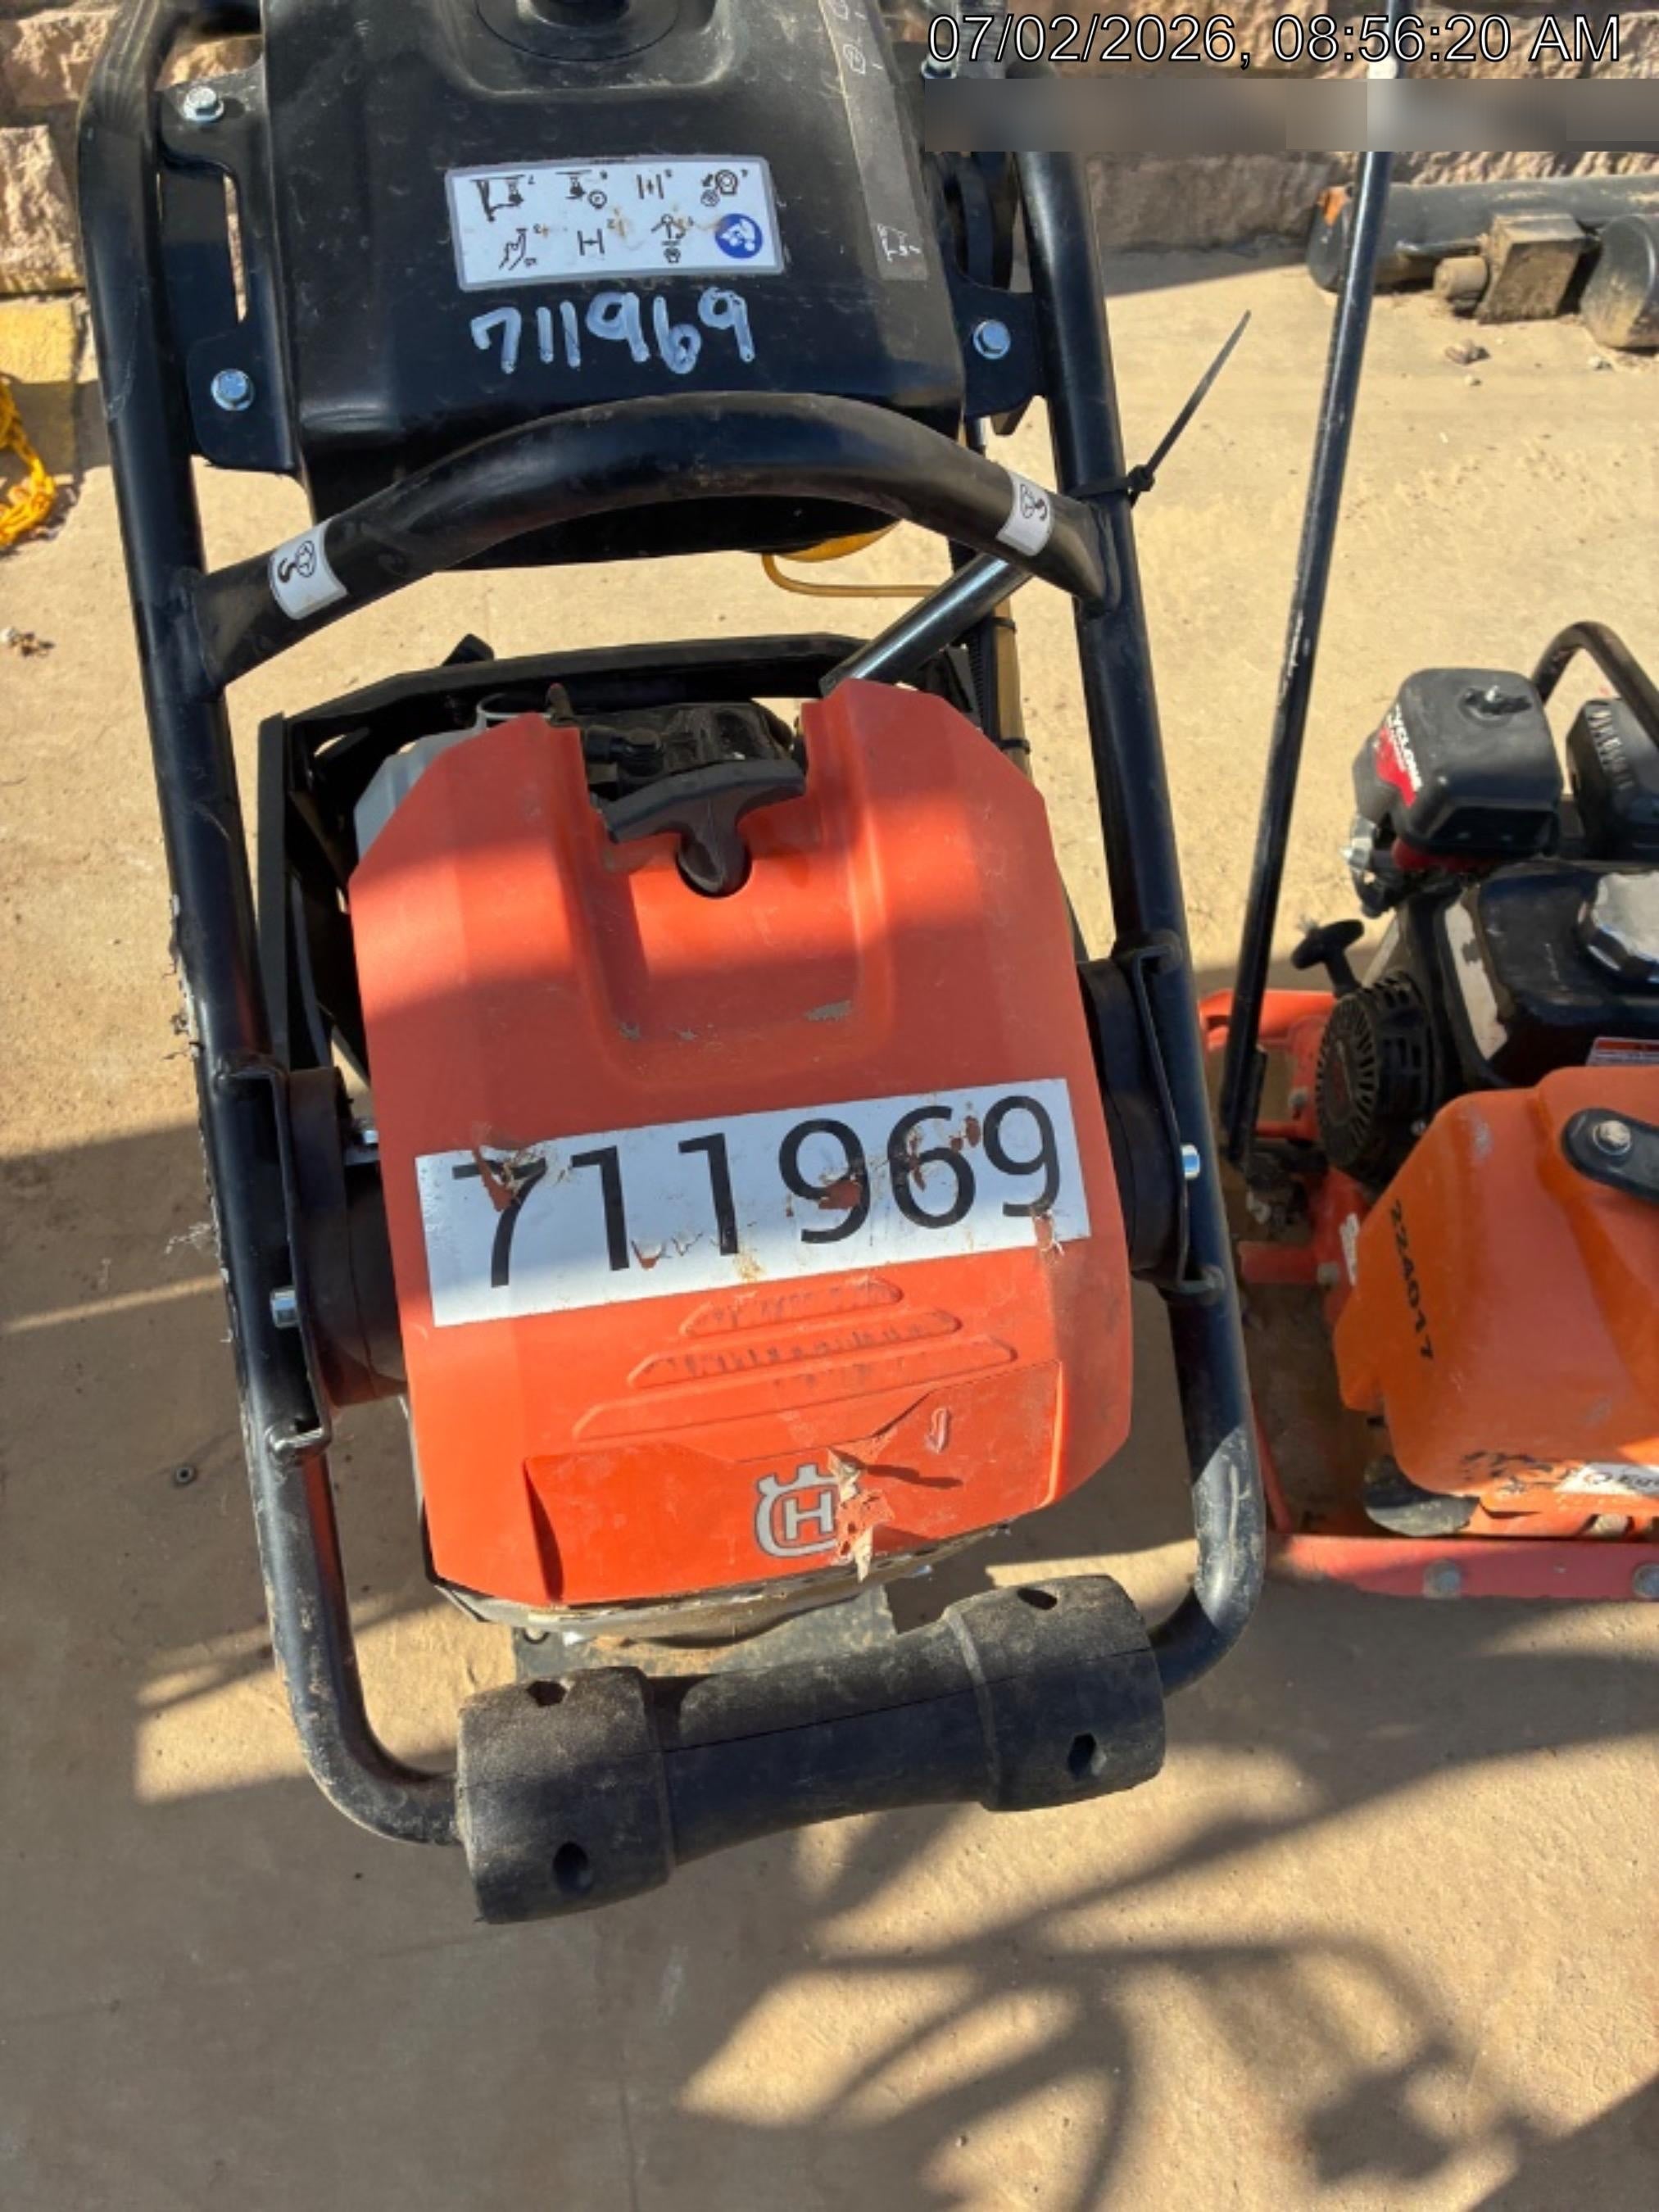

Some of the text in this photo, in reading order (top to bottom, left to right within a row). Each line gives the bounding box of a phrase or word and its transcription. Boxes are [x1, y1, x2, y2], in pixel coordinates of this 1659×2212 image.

[470, 288, 755, 374] 711969
[452, 1096, 1063, 1289] 711969
[1391, 1199, 1433, 1360] 224017
